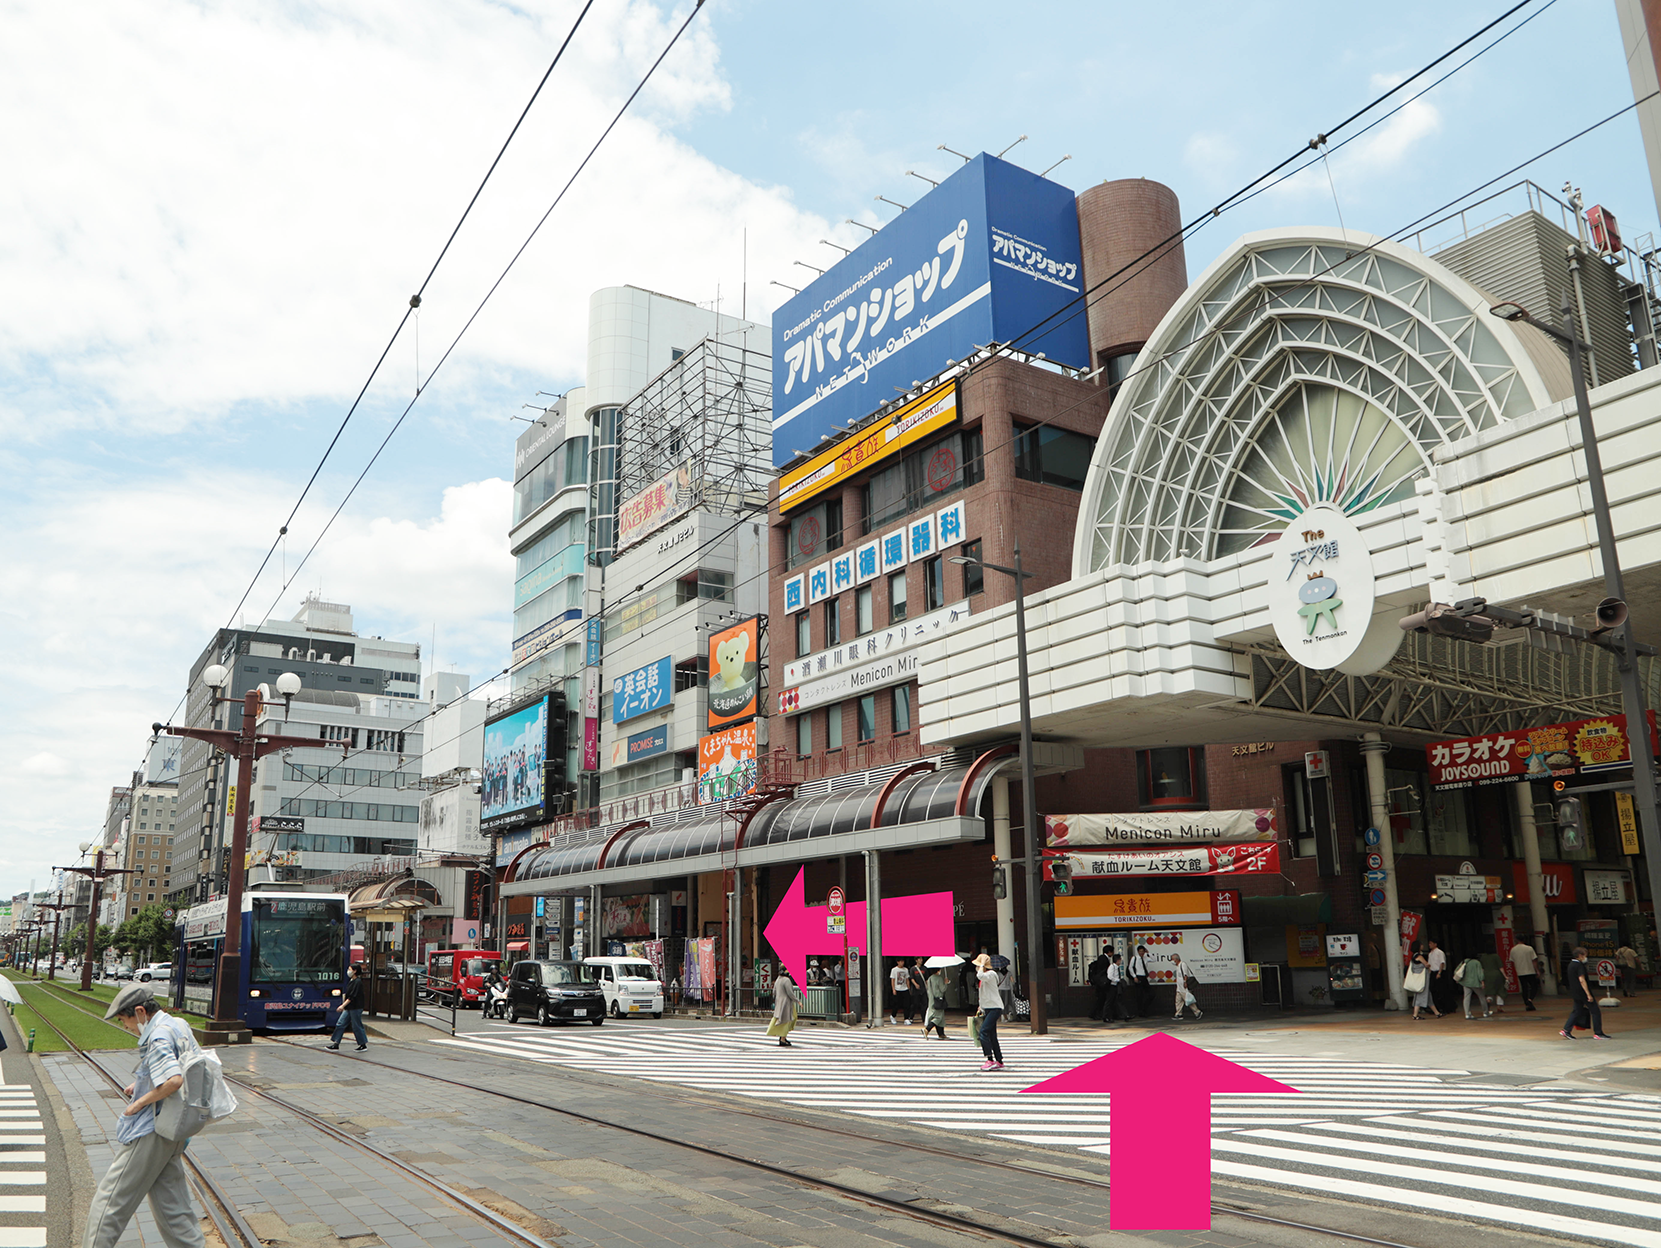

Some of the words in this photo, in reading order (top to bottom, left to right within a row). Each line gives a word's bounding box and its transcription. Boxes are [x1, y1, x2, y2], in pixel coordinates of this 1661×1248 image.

[991, 234, 1078, 280] アパマンショップ
[783, 218, 969, 395] アパマンショップ
[784, 309, 822, 342] Dramatic
[822, 257, 893, 309] Communication
[620, 484, 667, 536] 広告募集
[1301, 529, 1325, 543] The
[786, 507, 961, 610] 西内科循環器科
[1285, 540, 1340, 582] 天文館
[801, 609, 959, 678] 酒瀬川眼科クリニック
[1303, 638, 1313, 646] The
[1315, 630, 1348, 643] Tenmonkan
[624, 663, 659, 698] 英会話
[850, 662, 893, 688] Menicon
[804, 679, 848, 700] コンタクトレンズ
[620, 688, 662, 718] イーオン
[1586, 726, 1608, 737] 飲食物
[630, 736, 654, 754] PROMISE
[1232, 742, 1275, 757] 天文館ビル
[1431, 735, 1516, 767] カラオケ
[1580, 735, 1620, 753] 持込み
[1591, 749, 1612, 762] OK
[1440, 759, 1511, 782] JOYSOUND
[1104, 816, 1171, 824] コンタクトレンズ
[1105, 826, 1172, 841] Menicon
[1180, 825, 1221, 838] Miru
[504, 835, 529, 854] animate
[1240, 846, 1262, 855] こちら
[1107, 850, 1185, 860] たすけあいのオアシス
[1247, 856, 1267, 872] 2F
[1092, 858, 1202, 875] 献血ルーム天文館
[270, 901, 278, 914] 2
[278, 901, 327, 912] 鹿児島駅前
[1113, 897, 1152, 914] 鳥貴族
[1071, 948, 1080, 984] 献血ルーム
[317, 972, 340, 980] 1016
